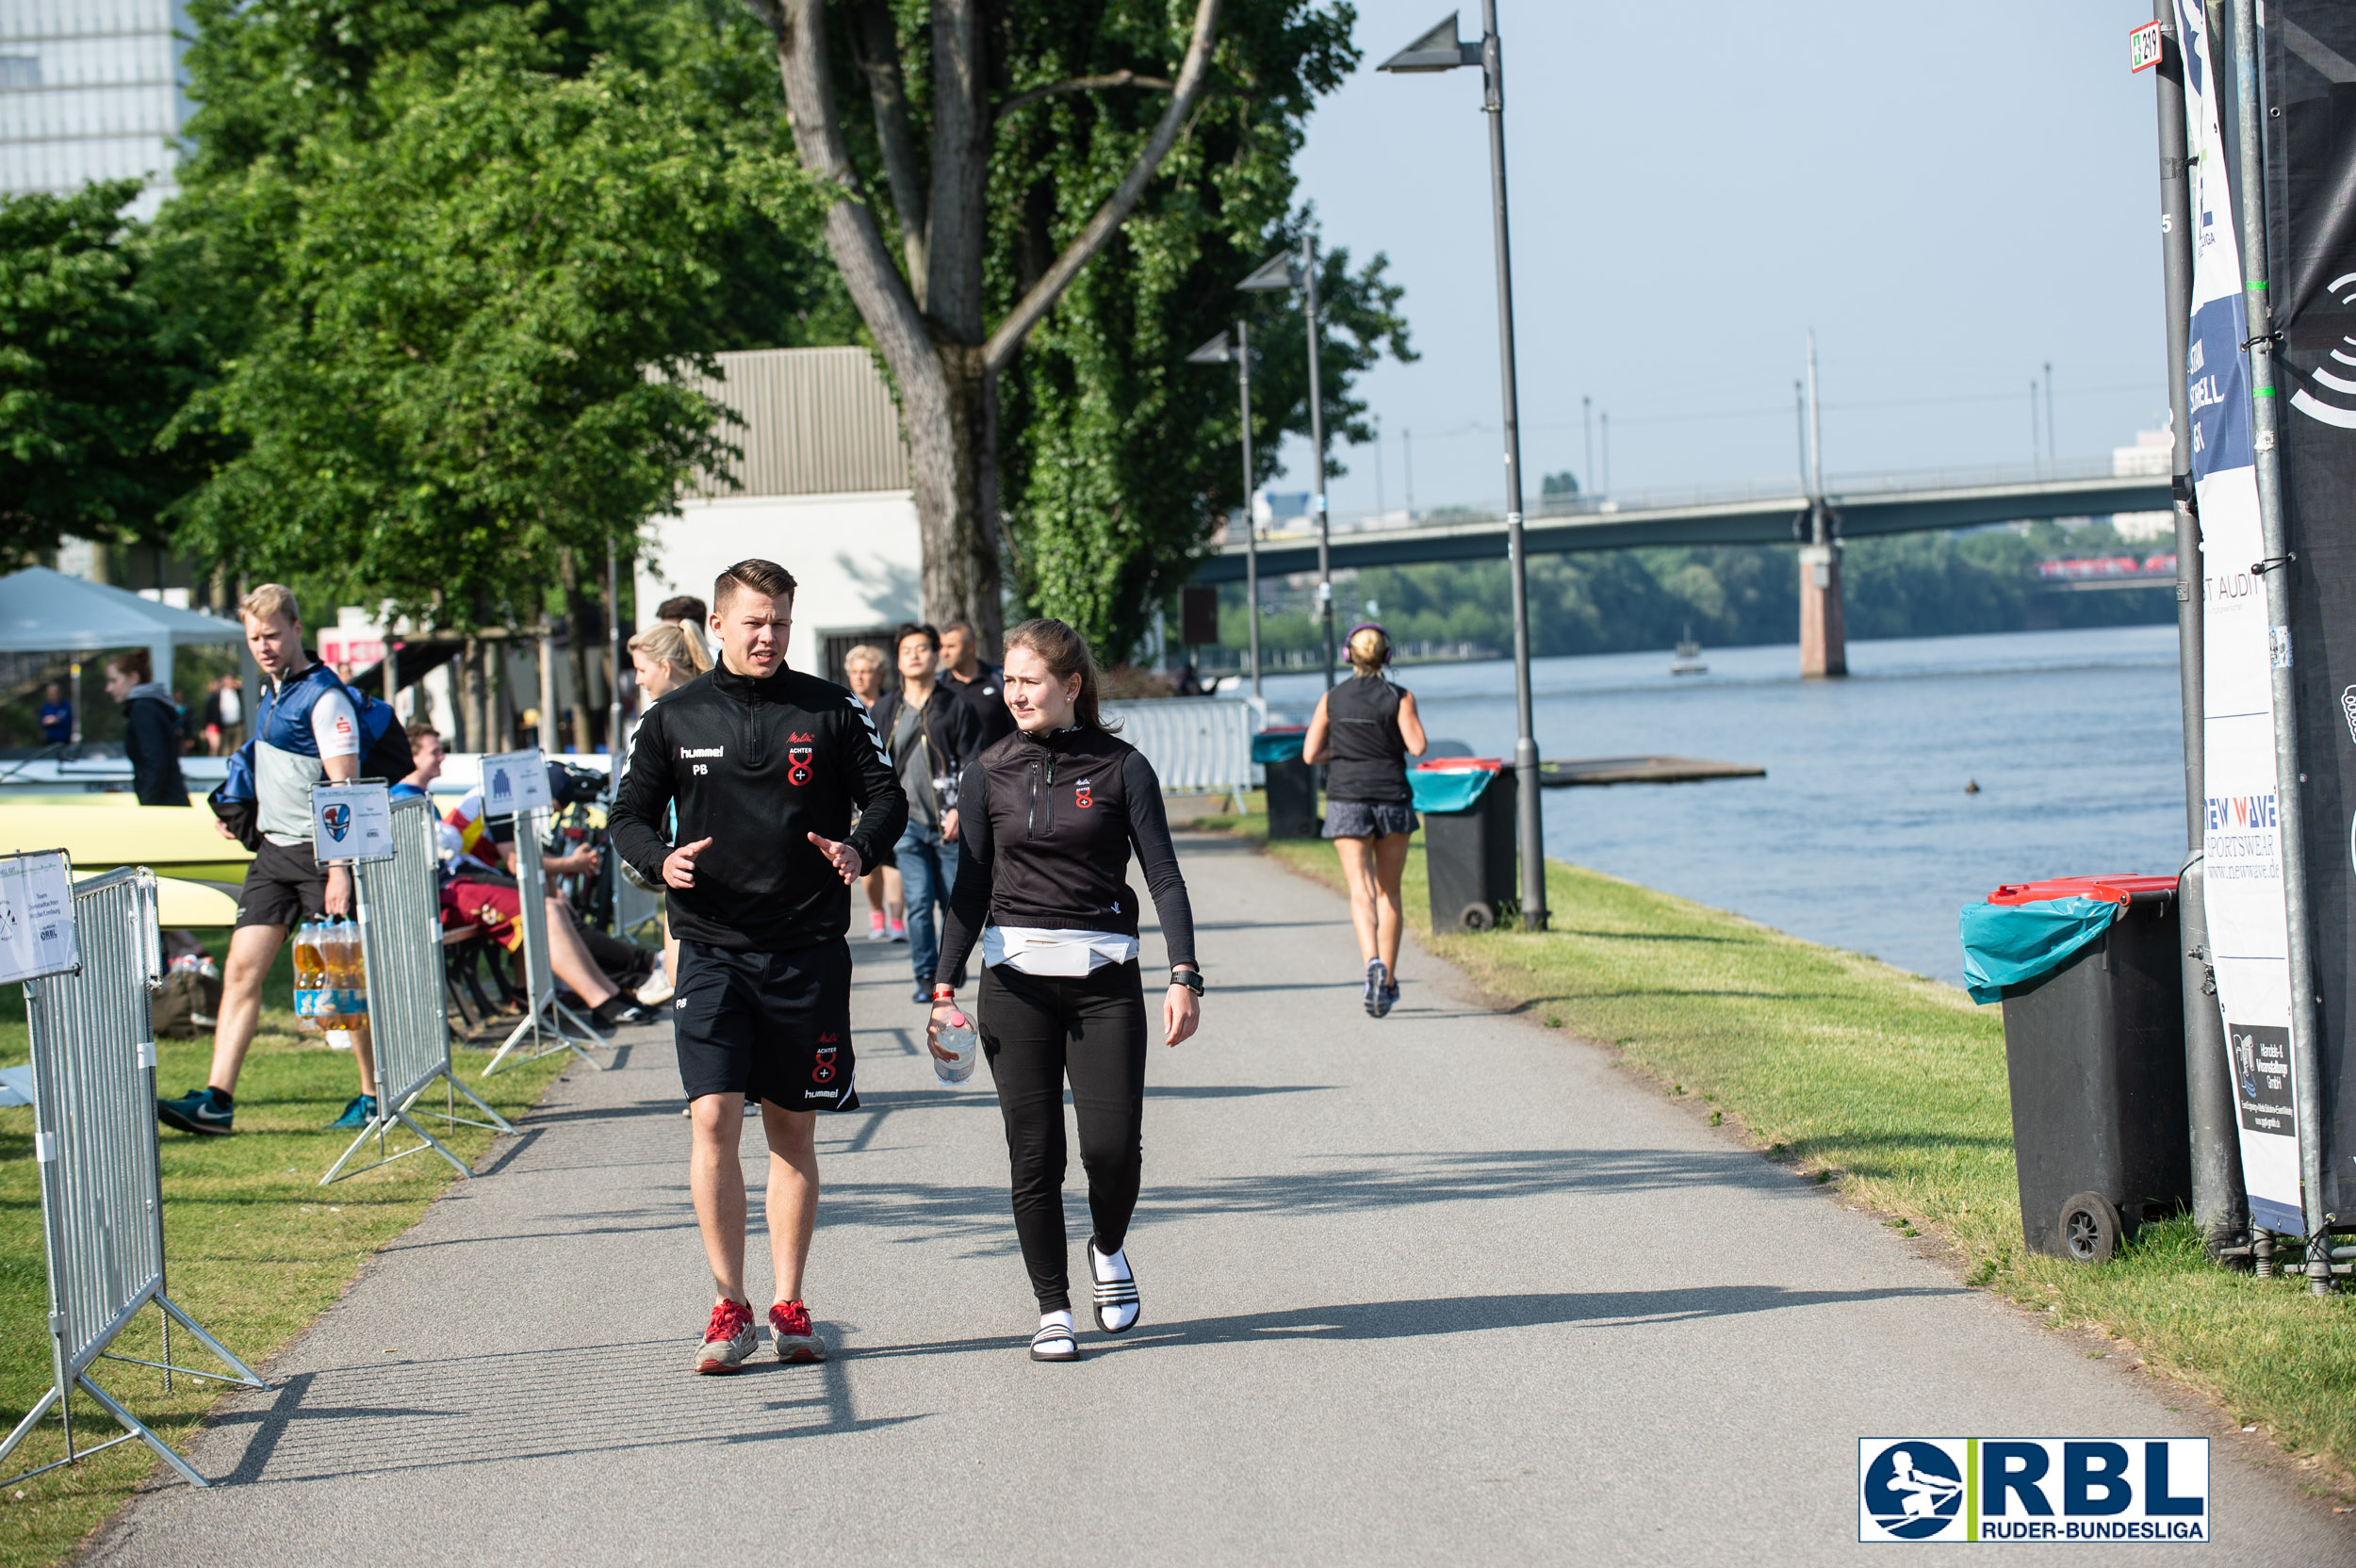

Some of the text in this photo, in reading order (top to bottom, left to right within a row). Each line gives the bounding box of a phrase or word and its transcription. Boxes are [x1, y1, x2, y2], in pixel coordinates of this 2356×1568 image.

[2143, 29, 2156, 59] 219
[2219, 571, 2259, 599] AUDIT
[680, 745, 724, 759] hummel
[693, 764, 709, 776] PB
[2233, 794, 2276, 828] WAVE
[2207, 859, 2280, 880] www.newwave.de
[676, 998, 687, 1009] PB
[2266, 1075, 2282, 1090] GmbH
[805, 1088, 839, 1100] hummel
